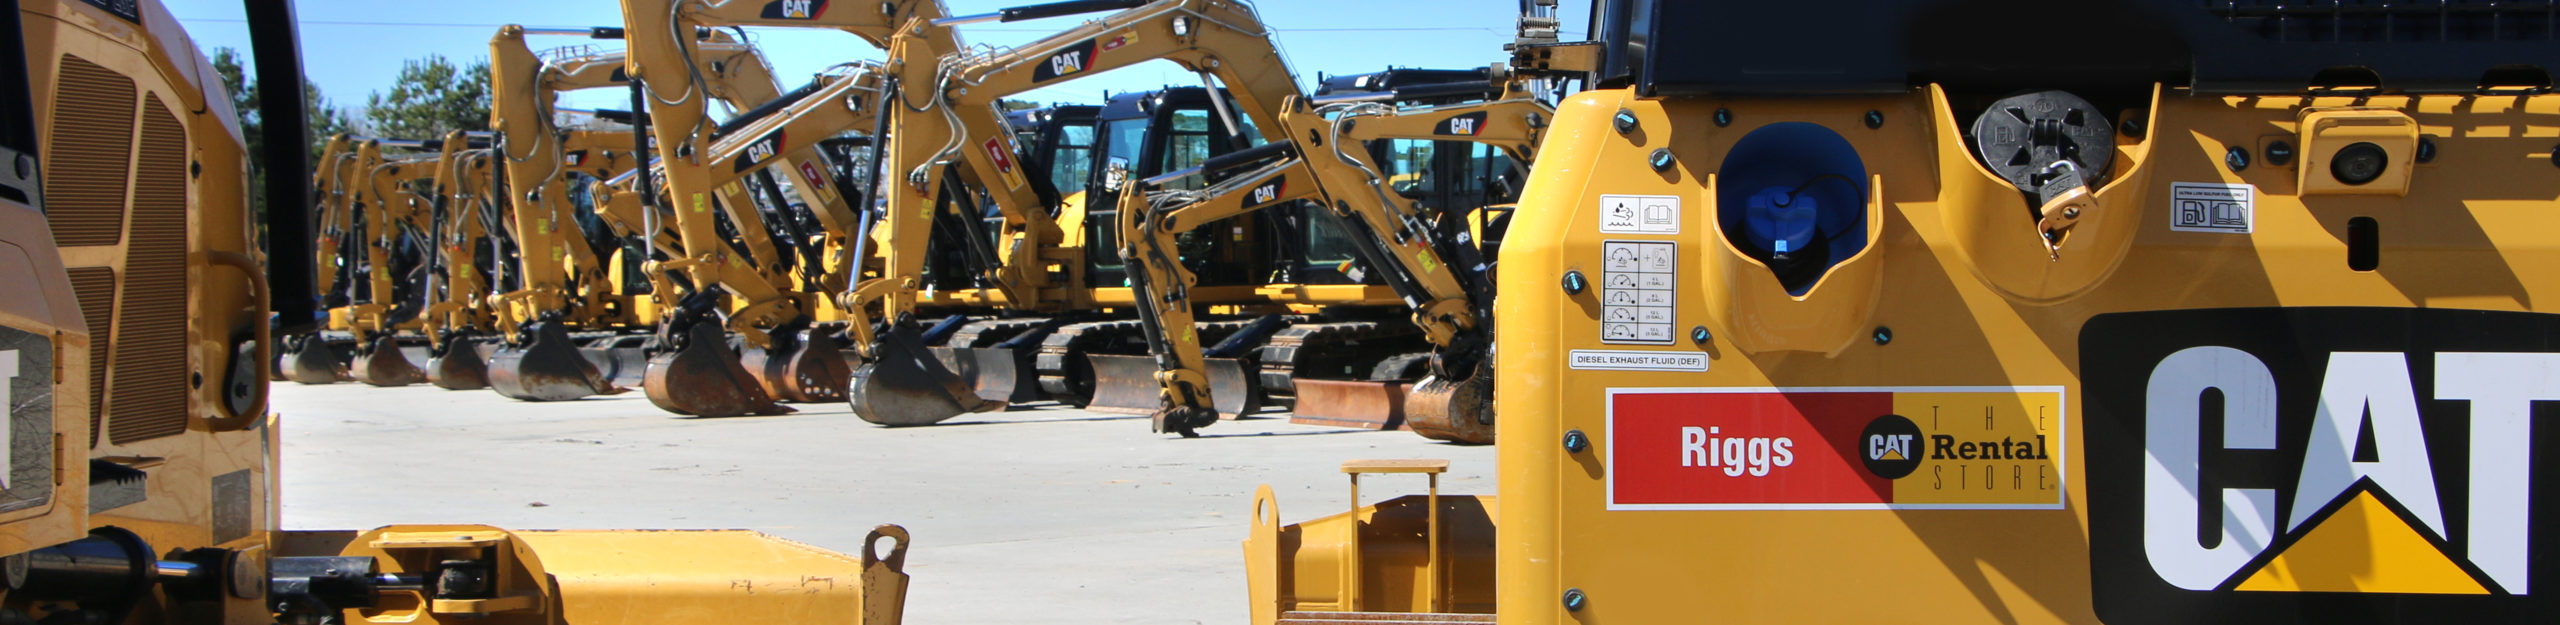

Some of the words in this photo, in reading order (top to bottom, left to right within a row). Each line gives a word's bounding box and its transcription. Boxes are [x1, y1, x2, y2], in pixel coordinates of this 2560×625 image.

[782, 0, 811, 18] CAT
[1052, 51, 1081, 76] CAT
[1451, 118, 1474, 134] CAT
[566, 155, 578, 165] AT
[747, 139, 775, 164] CAT
[1255, 184, 1275, 204] CAT
[1609, 356, 1648, 364] EXHAUST
[1651, 357, 1676, 365] FLUID
[1677, 357, 1700, 366] (DEF)
[1932, 406, 2045, 430] THE
[1681, 426, 1794, 477] Riggs
[1869, 434, 1913, 460] CAT
[1931, 433, 2048, 460] Rental
[1934, 465, 2046, 490] STORE
[2144, 345, 2560, 595] CAT
